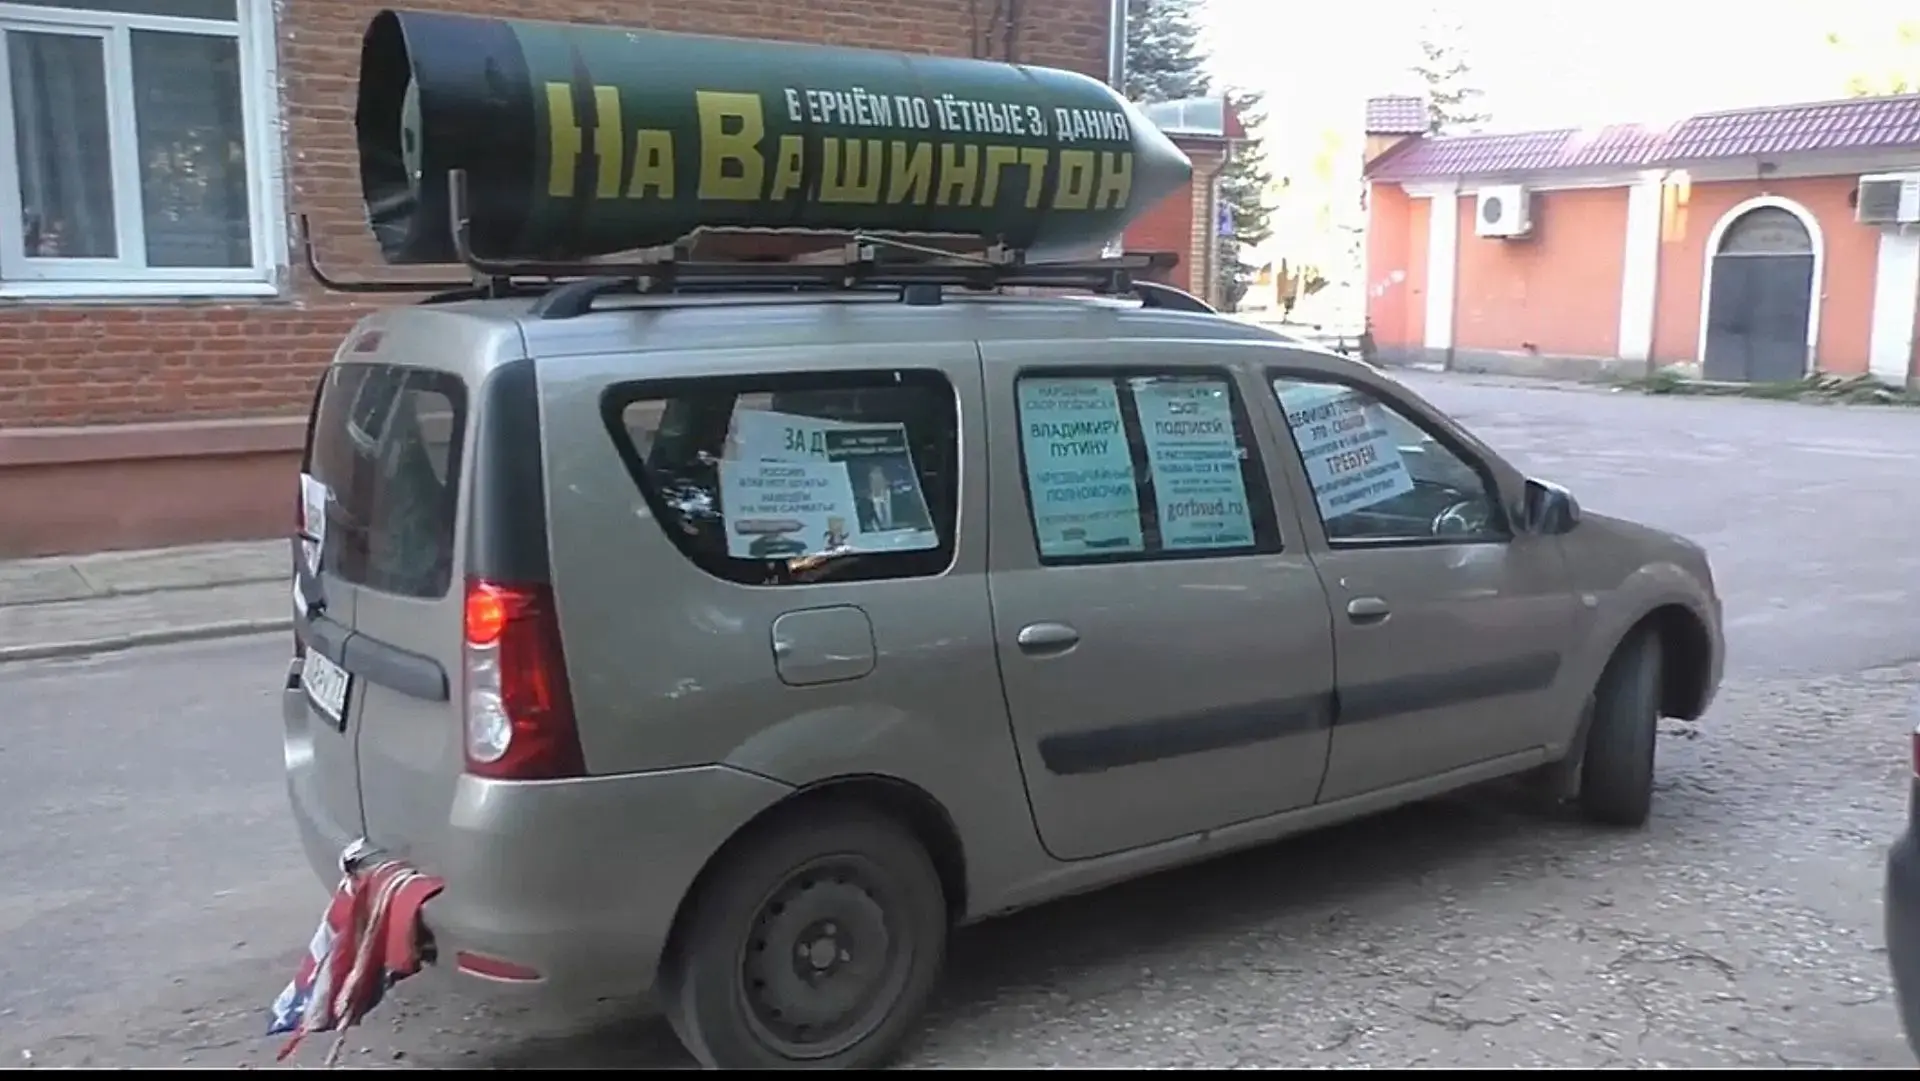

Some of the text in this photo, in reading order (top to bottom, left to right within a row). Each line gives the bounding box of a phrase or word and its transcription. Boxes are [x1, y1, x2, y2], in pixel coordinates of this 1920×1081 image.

[1026, 105, 1131, 142] ЗДАНИЯ
[785, 427, 806, 452] ЗА
[1031, 420, 1119, 438] ВЛАДИМИРУ
[1050, 440, 1108, 457] ПУТИНУ
